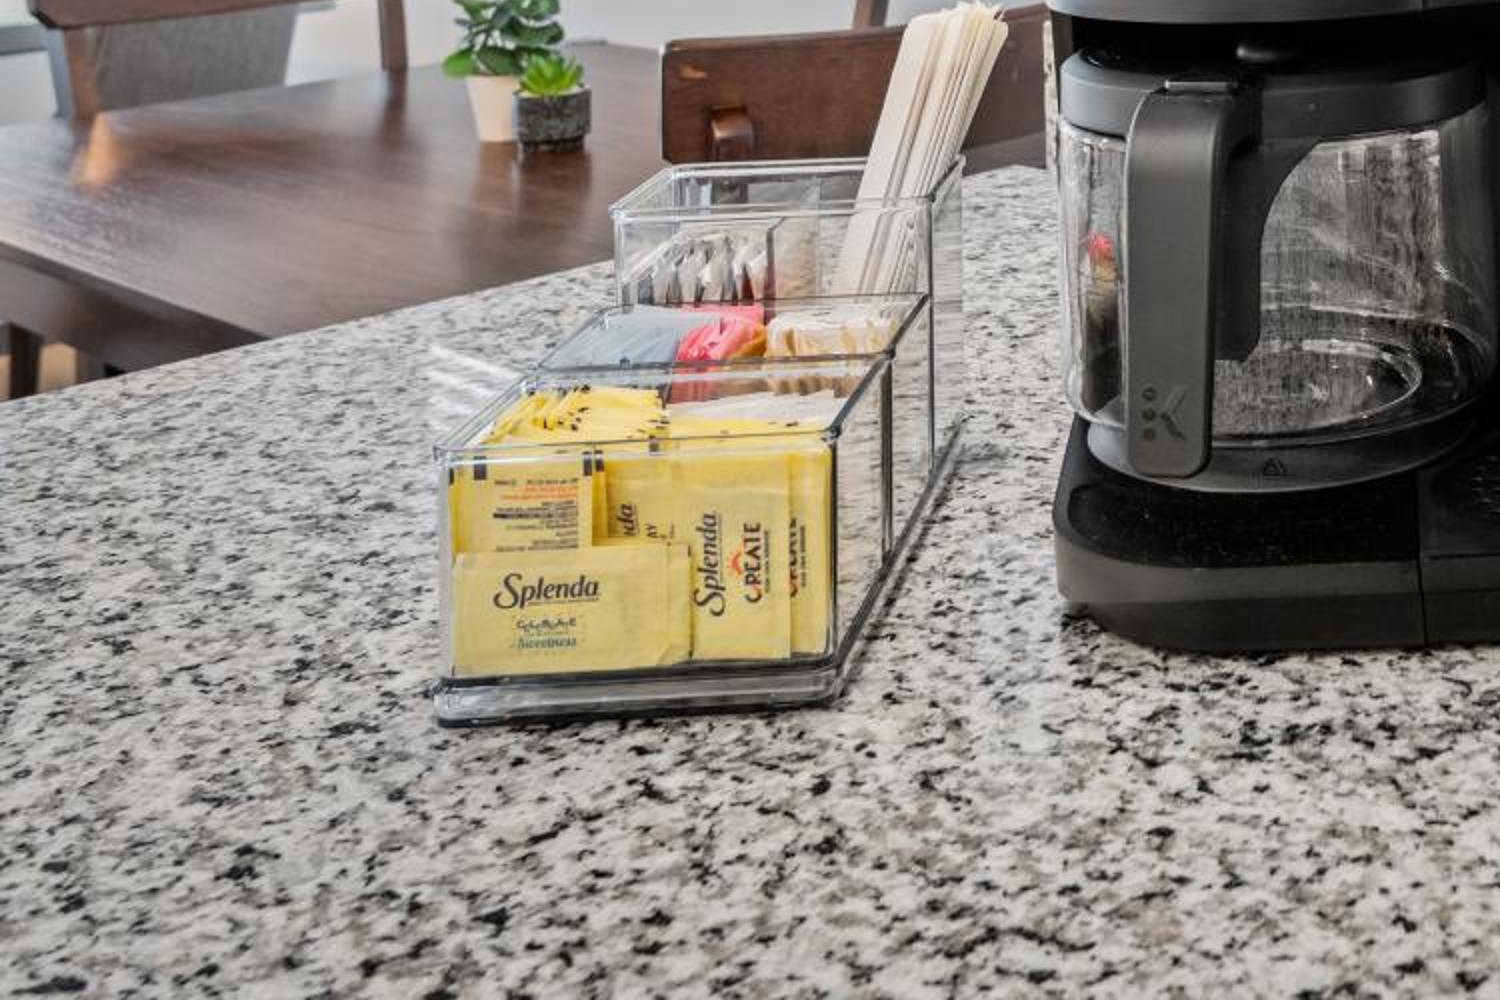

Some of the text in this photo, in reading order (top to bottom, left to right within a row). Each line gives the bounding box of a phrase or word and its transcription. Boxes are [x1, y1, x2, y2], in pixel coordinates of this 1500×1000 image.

[493, 572, 600, 609] Splenda
[692, 511, 727, 617] Splenda
[743, 522, 763, 604] CREATE
